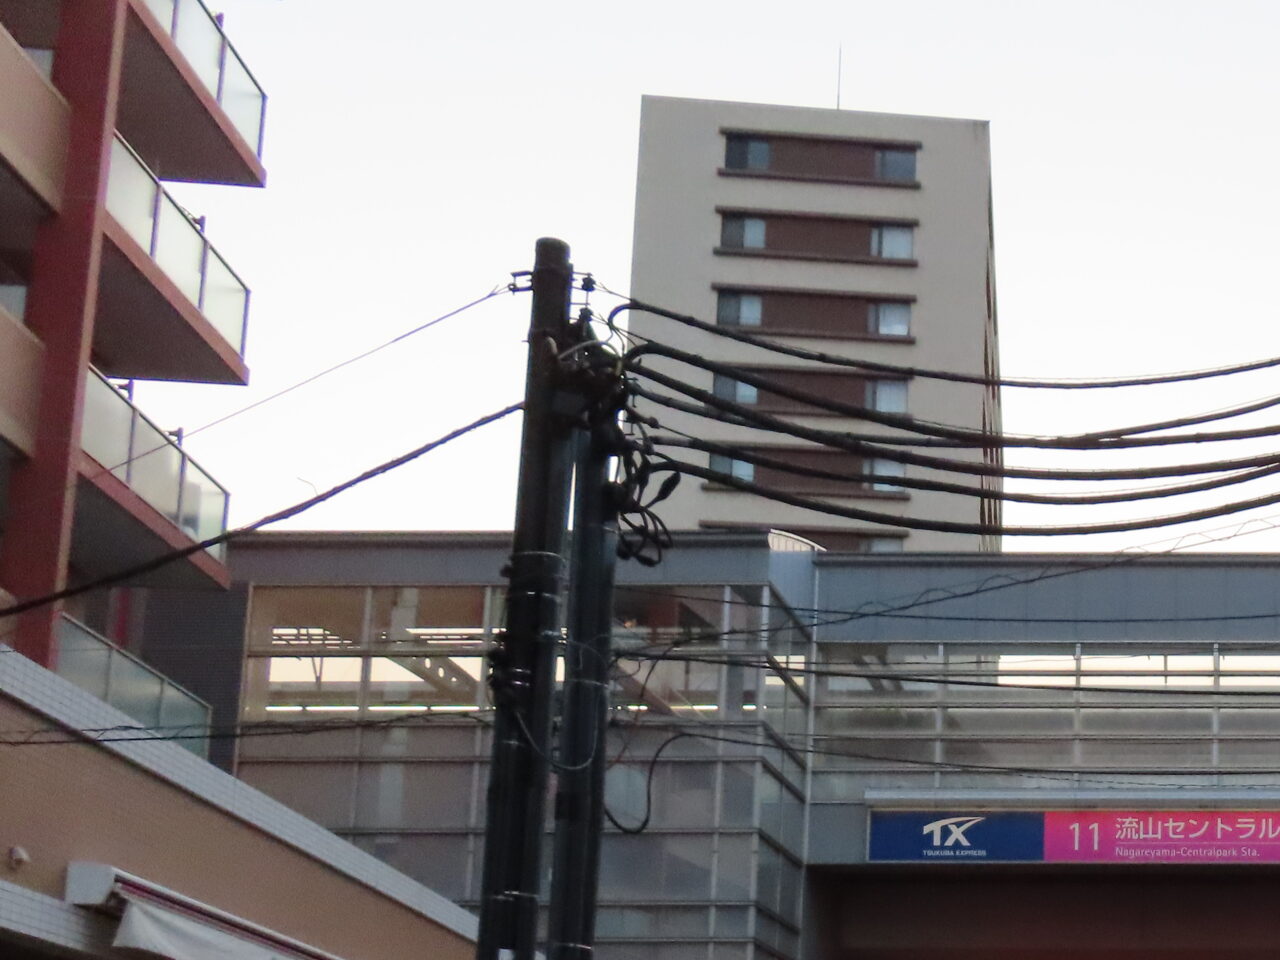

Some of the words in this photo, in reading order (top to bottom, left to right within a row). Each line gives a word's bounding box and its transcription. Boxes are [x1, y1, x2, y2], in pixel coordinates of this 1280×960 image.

[923, 817, 986, 846] TX
[1069, 822, 1100, 850] 11
[1115, 847, 1236, 858] Nagareyama-Centralpark
[1241, 847, 1260, 857] Sta.
